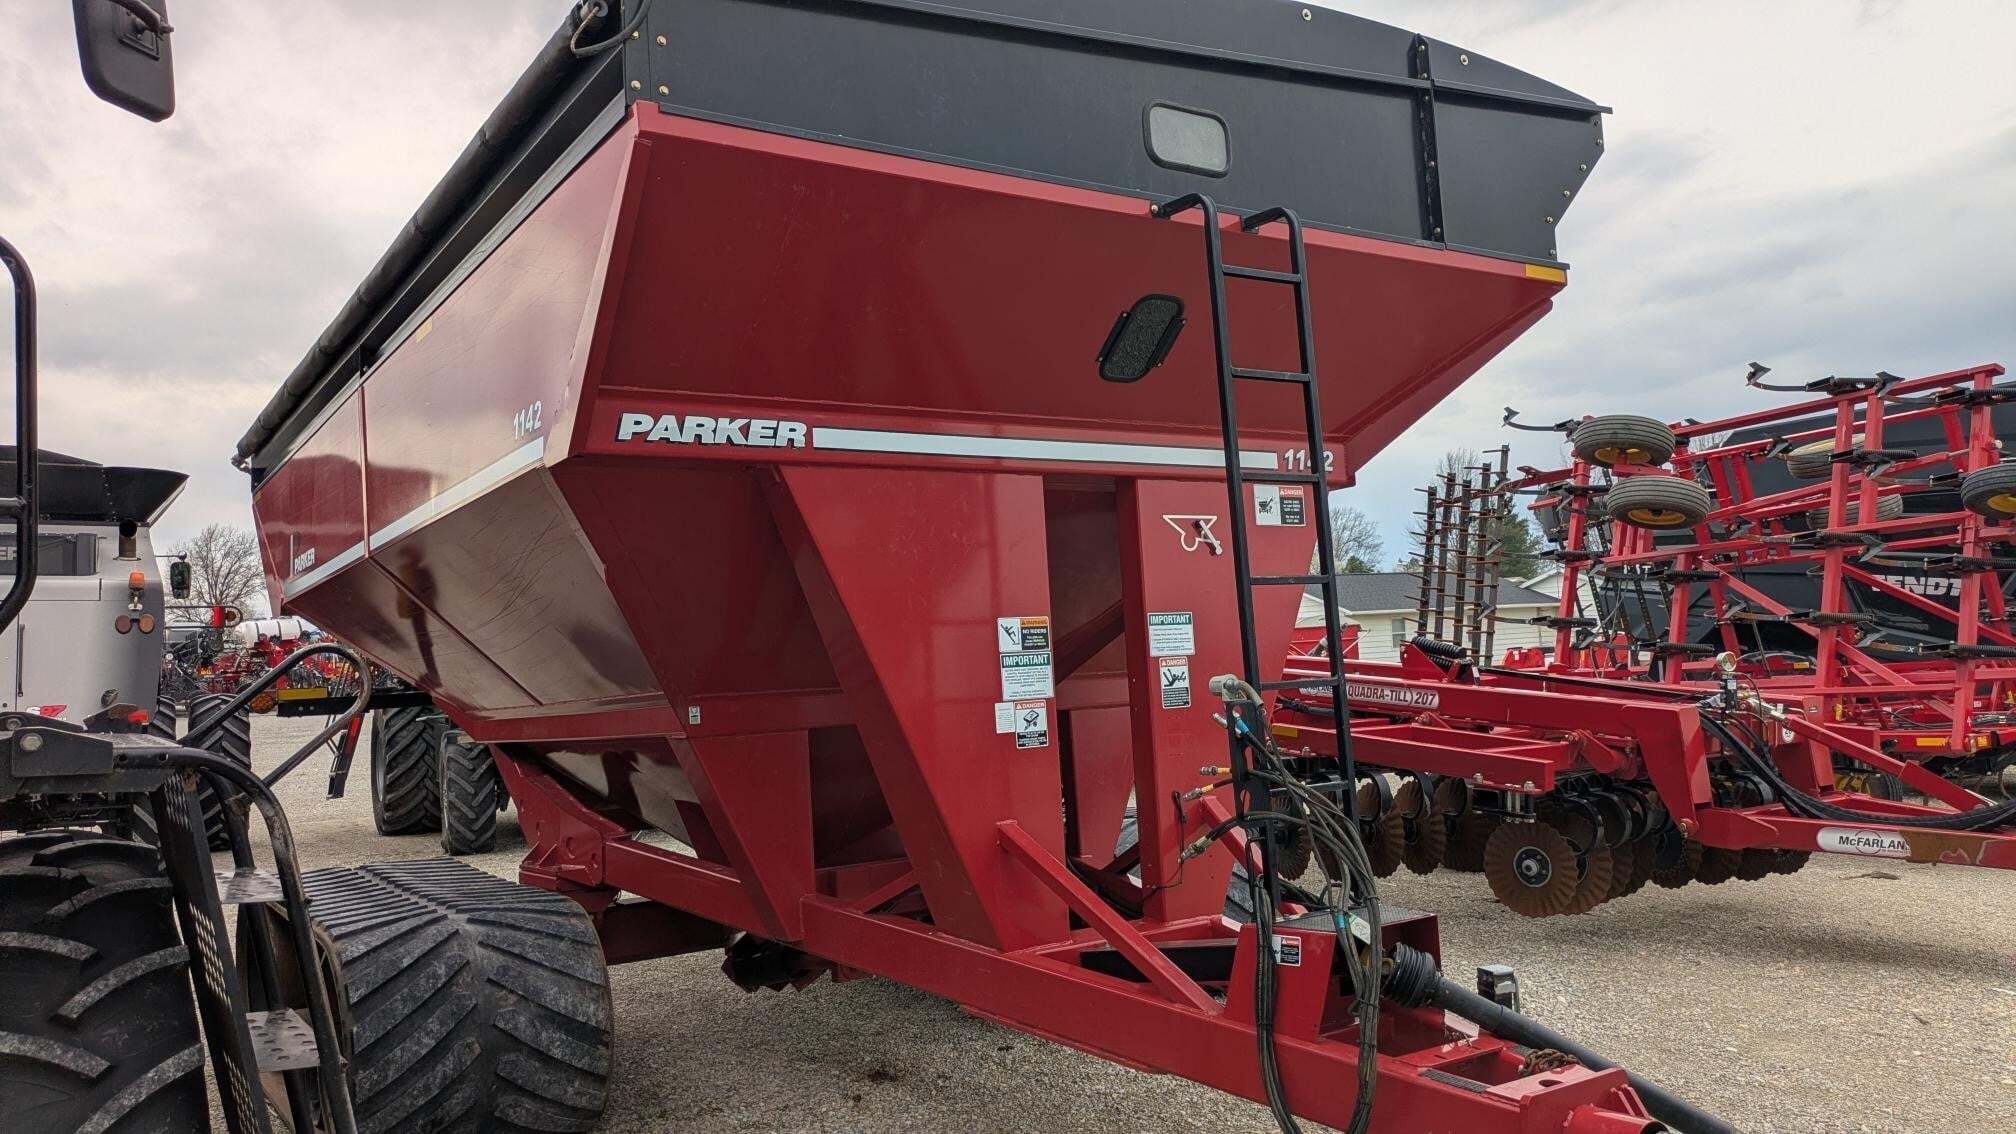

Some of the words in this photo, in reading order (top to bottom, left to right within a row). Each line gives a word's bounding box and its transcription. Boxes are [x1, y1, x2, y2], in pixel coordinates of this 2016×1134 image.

[513, 401, 542, 440] 1142
[617, 413, 807, 448] PARKER
[1284, 448, 1334, 472] 112
[294, 547, 315, 575] PARKER
[1150, 614, 1190, 625] IMPORTANT
[1003, 654, 1049, 667] IMPORTANT
[1415, 691, 1437, 706] 207
